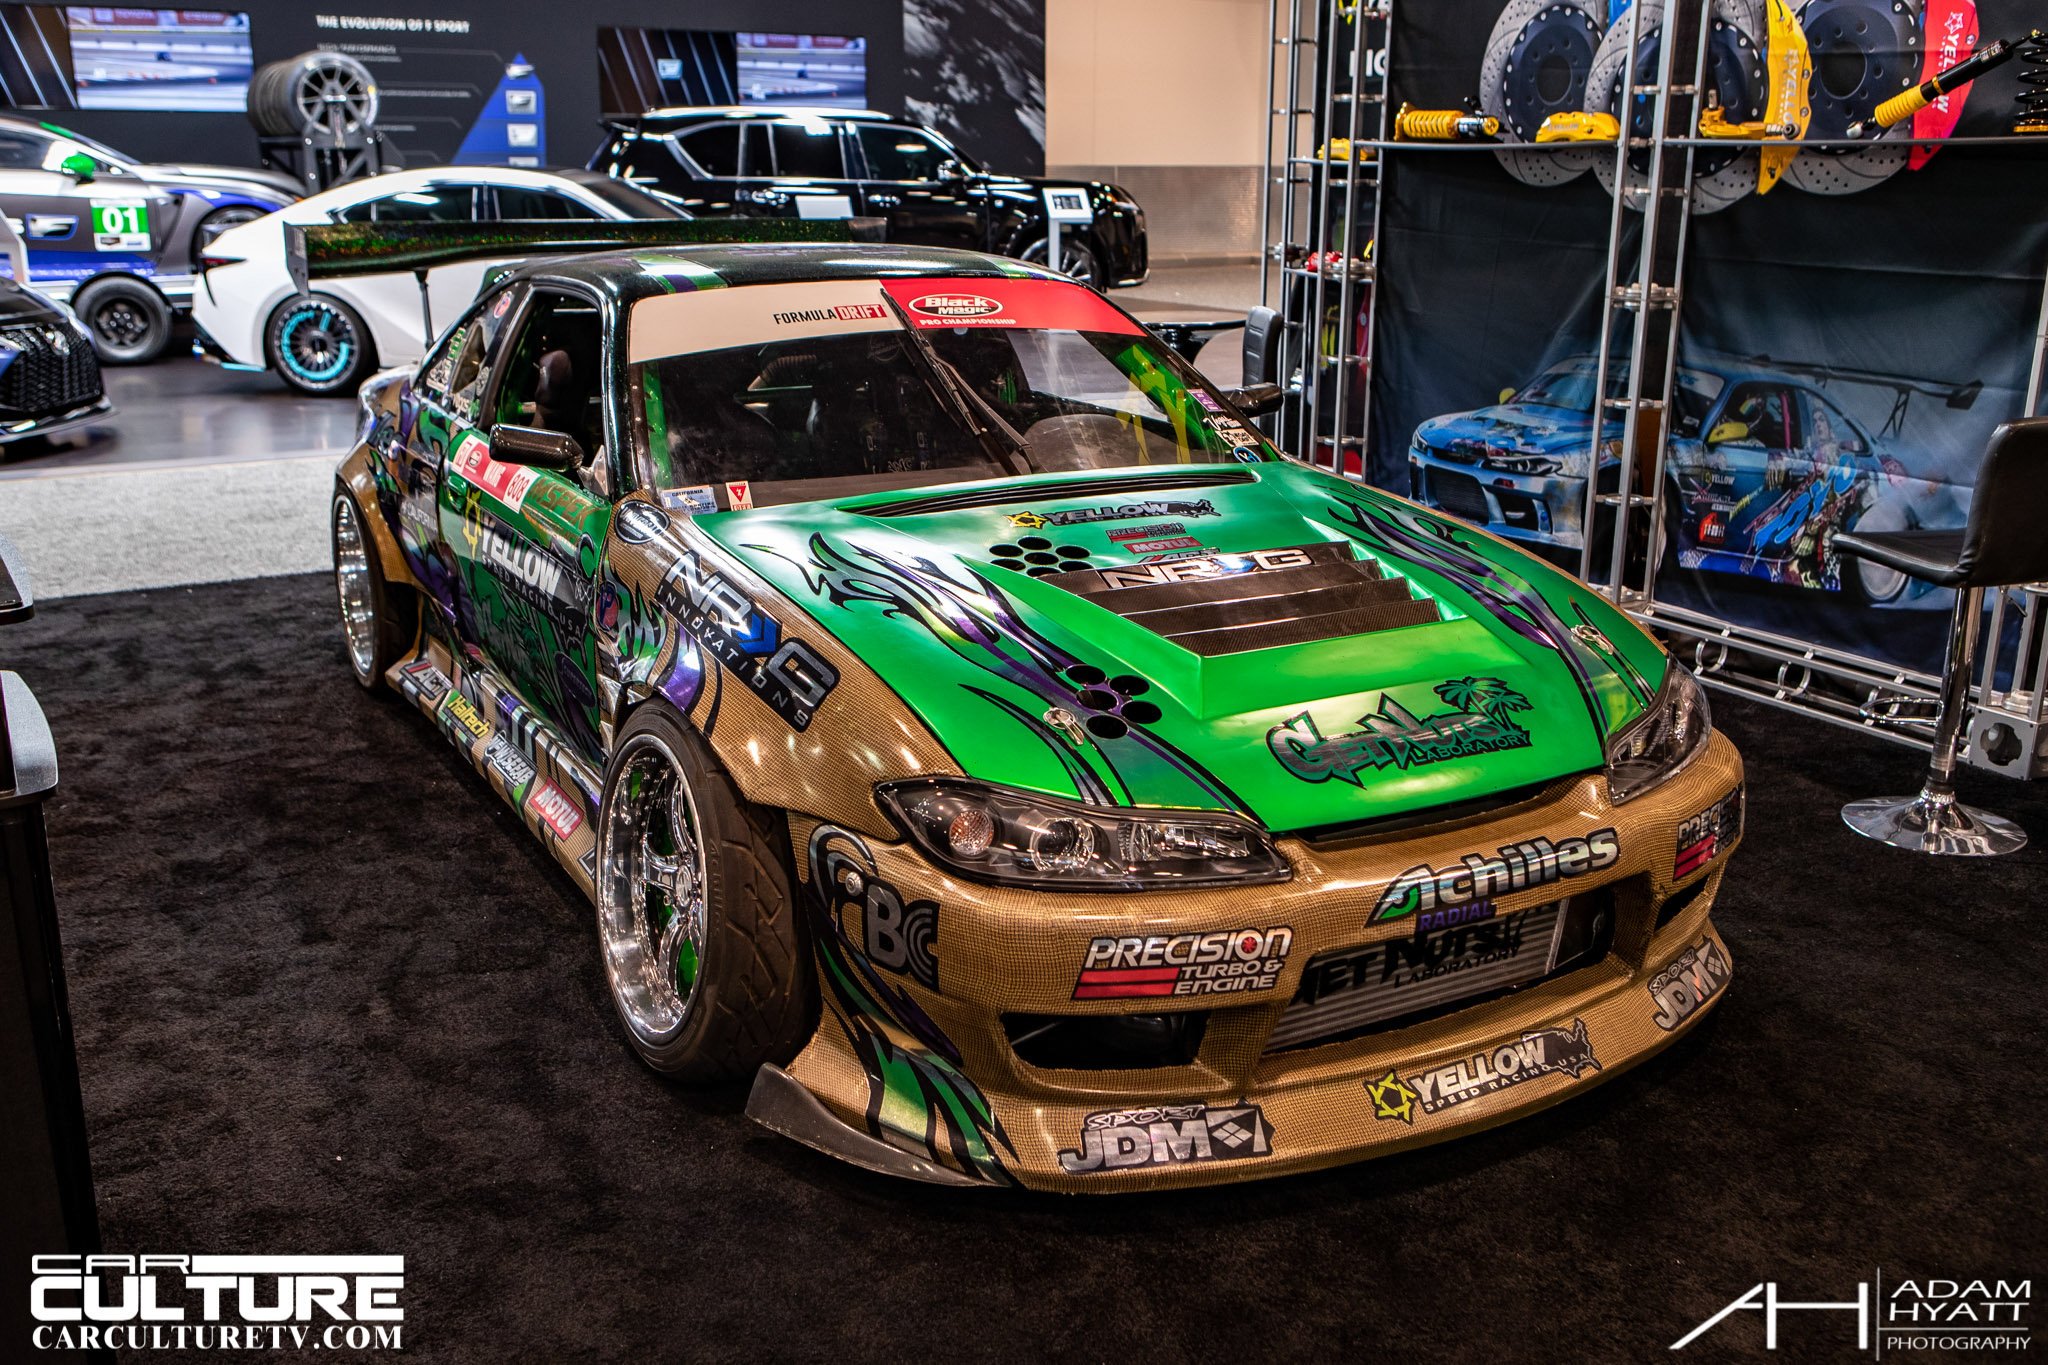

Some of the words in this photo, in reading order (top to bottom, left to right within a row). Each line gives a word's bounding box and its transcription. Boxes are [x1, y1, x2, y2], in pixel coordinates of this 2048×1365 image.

[316, 15, 339, 28] THE
[340, 16, 406, 30] EVOLUTION
[407, 18, 423, 31] OF
[434, 20, 470, 33] SPORT
[102, 207, 140, 234] 01
[773, 309, 837, 324] FORMULA
[840, 304, 882, 320] DRIFT
[925, 297, 988, 308] Black
[938, 306, 991, 315] Magic
[942, 318, 1016, 326] CHAMPIONSHIP
[507, 474, 530, 502] 808
[671, 489, 704, 497] CALIFORNIA
[1041, 501, 1170, 524] YELLOW
[481, 520, 562, 598] YELLOW
[1131, 538, 1196, 553] MOTUL
[514, 580, 559, 620] RACING
[559, 612, 581, 638] USA
[657, 584, 809, 727] INNOVATIONS
[447, 694, 491, 739] Haltech
[1409, 733, 1530, 763] LABORATORY
[534, 786, 581, 834] MOTUL
[1373, 829, 1619, 920] Achilles
[1420, 900, 1492, 930] RADIAL
[1085, 926, 1293, 968] PRECISION
[1180, 960, 1261, 979] TURBO
[1264, 959, 1283, 973] &
[1394, 943, 1520, 988] LABORATORY
[1649, 947, 1696, 995] SPORT
[1174, 974, 1276, 995] ENGINE
[1654, 960, 1718, 1028] JDM
[1410, 1037, 1546, 1103] YELLOW
[1424, 1087, 1480, 1113] SPEED
[1489, 1065, 1551, 1090] RACING
[1558, 1052, 1588, 1068] USA
[1088, 1105, 1205, 1130] SPORT
[1061, 1119, 1213, 1172] JDM
